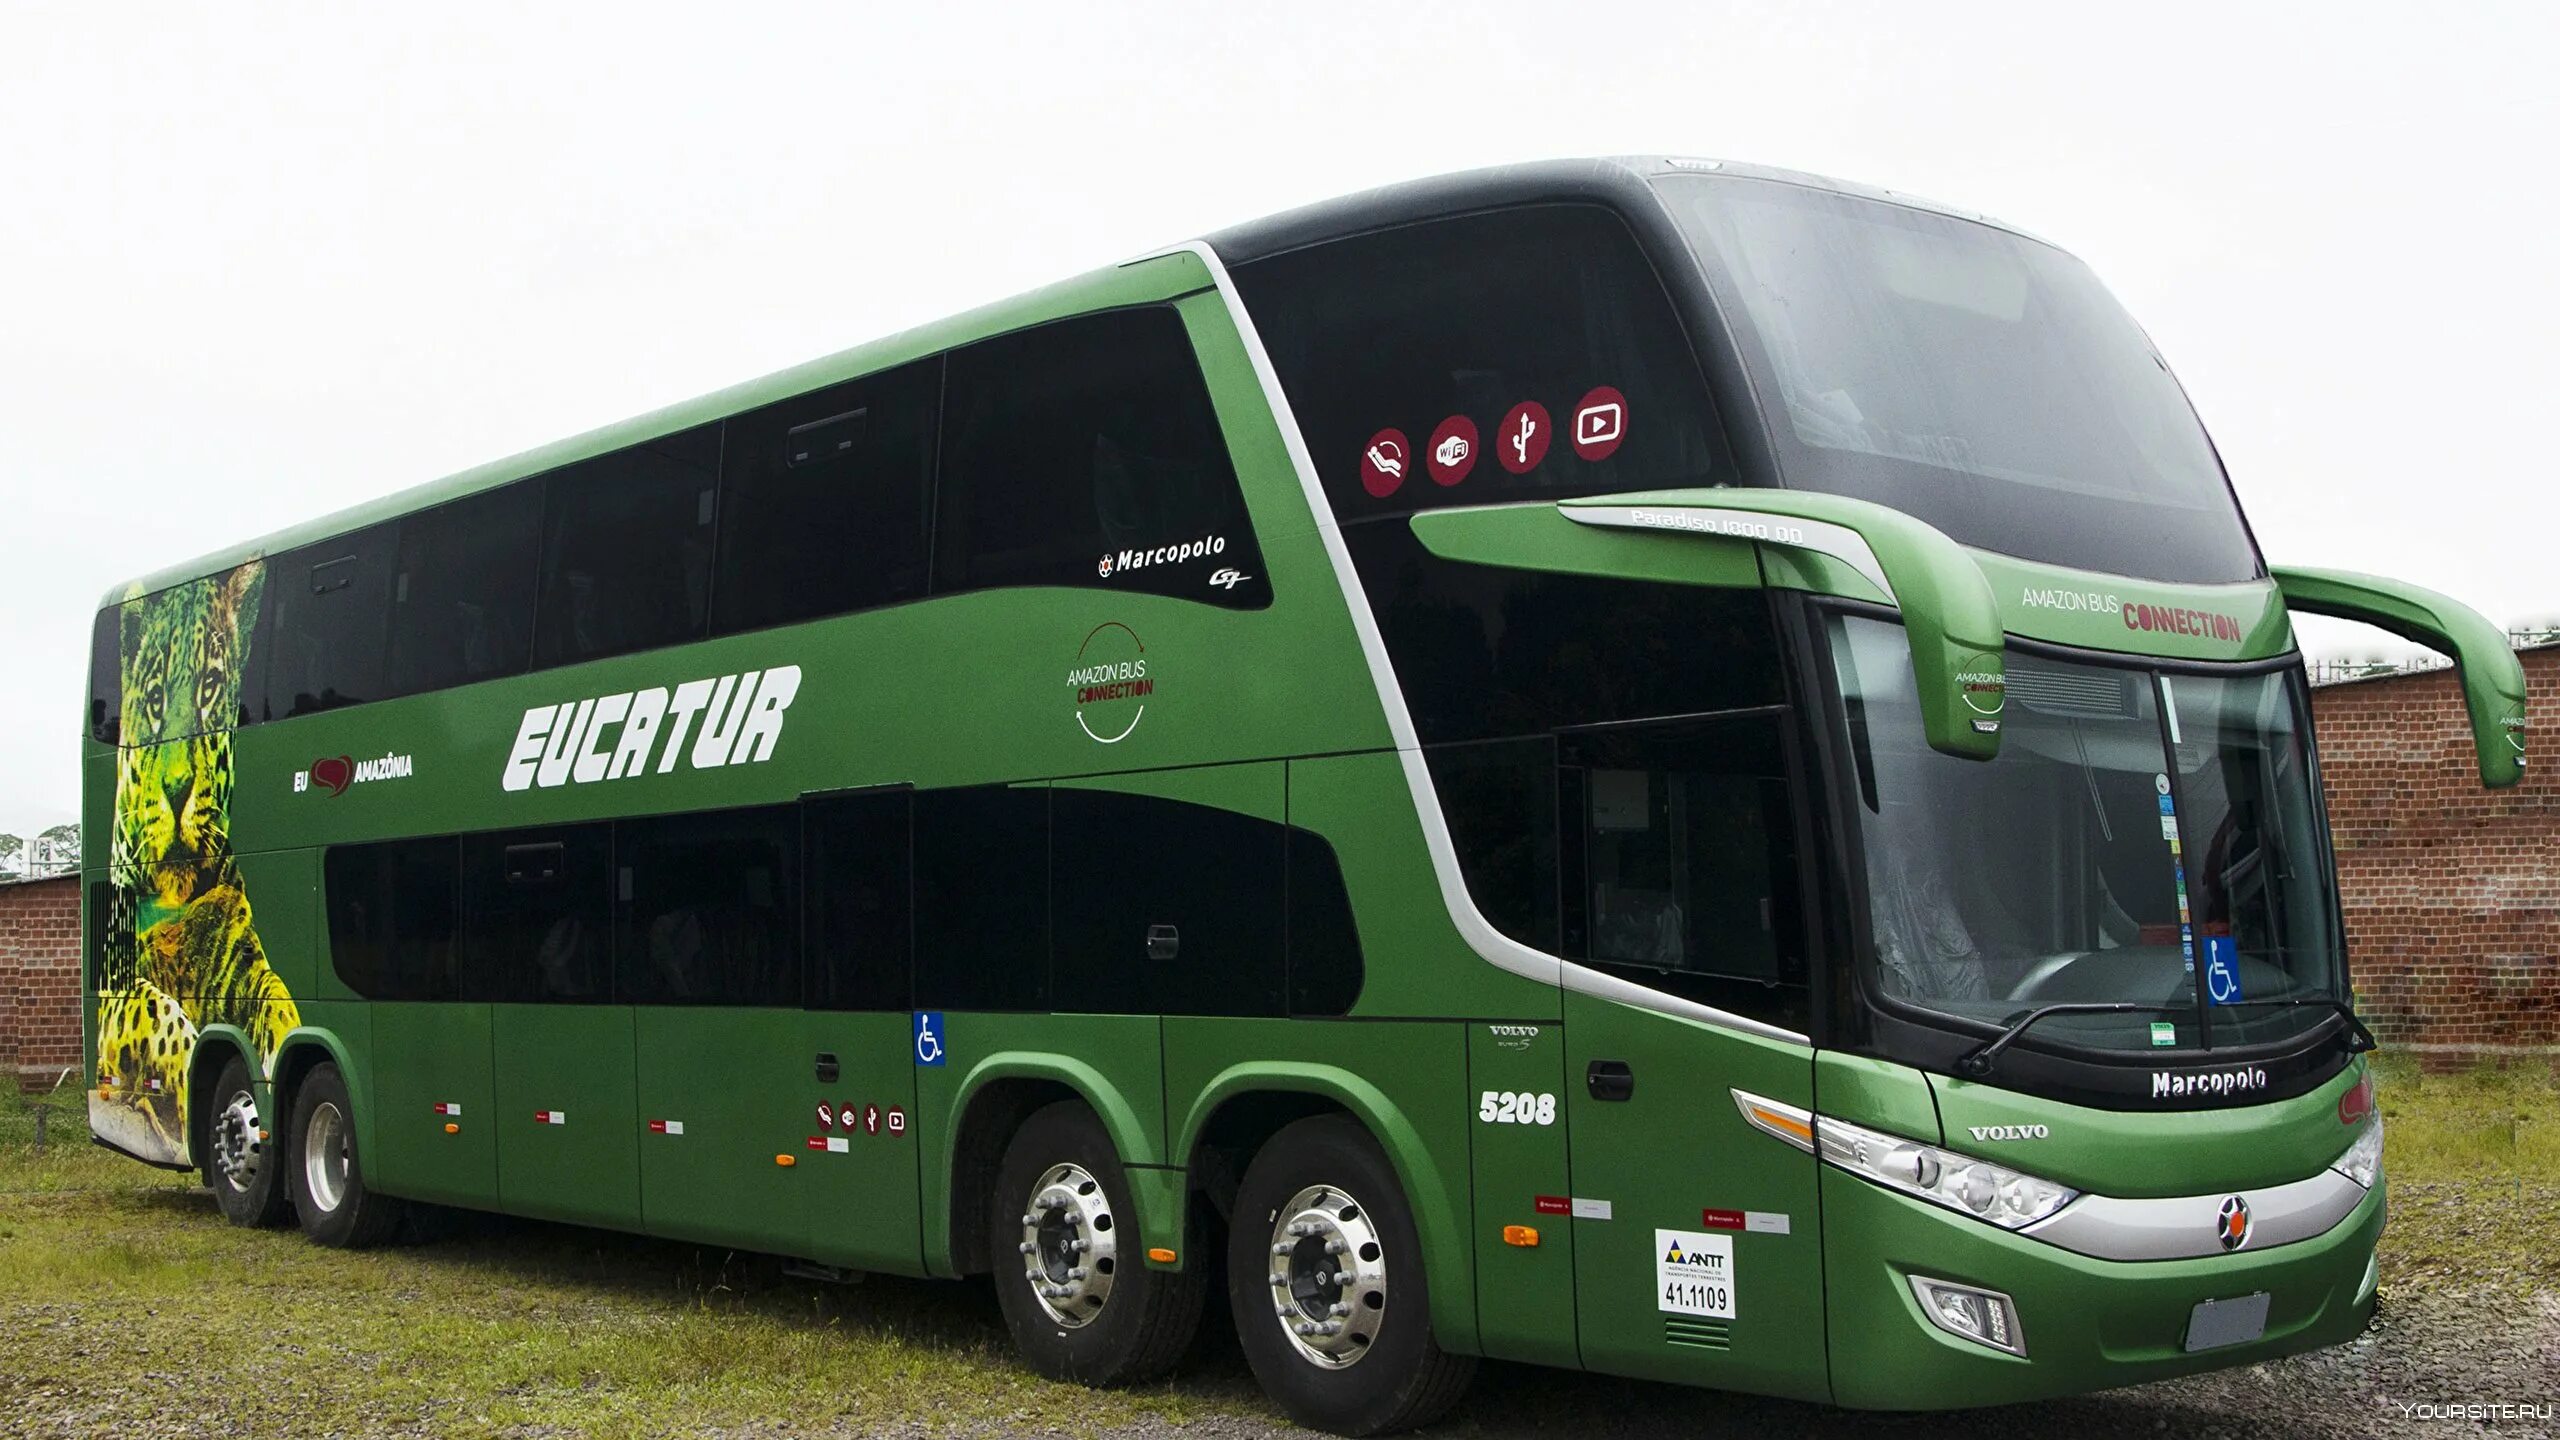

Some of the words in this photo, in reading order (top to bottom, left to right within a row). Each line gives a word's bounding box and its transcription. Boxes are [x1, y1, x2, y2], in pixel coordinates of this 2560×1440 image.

[1631, 509, 1717, 532] Paradiso
[1723, 519, 1768, 541] 1800
[1116, 535, 1226, 572] Marcopolo
[2022, 587, 2087, 611] AMAZON
[2090, 593, 2119, 613] BUS
[2123, 602, 2241, 643] CONNECTION
[1066, 664, 1118, 687] AMAZON
[1120, 660, 1146, 680] BUS
[1955, 672, 1995, 683] AMAZON
[1077, 679, 1154, 704] CONNECTION
[502, 664, 802, 792] EUCATUR
[293, 771, 308, 792] EU
[353, 751, 412, 783] AMAZÔNIA
[1489, 1025, 1539, 1037] VOLVO
[2152, 1067, 2266, 1098] Marcopolo
[1479, 1091, 1556, 1126] 5208
[1968, 1124, 2049, 1141] VOLVO
[1687, 1252, 1724, 1268] ANTT
[1666, 1281, 1727, 1311] 41.1109
